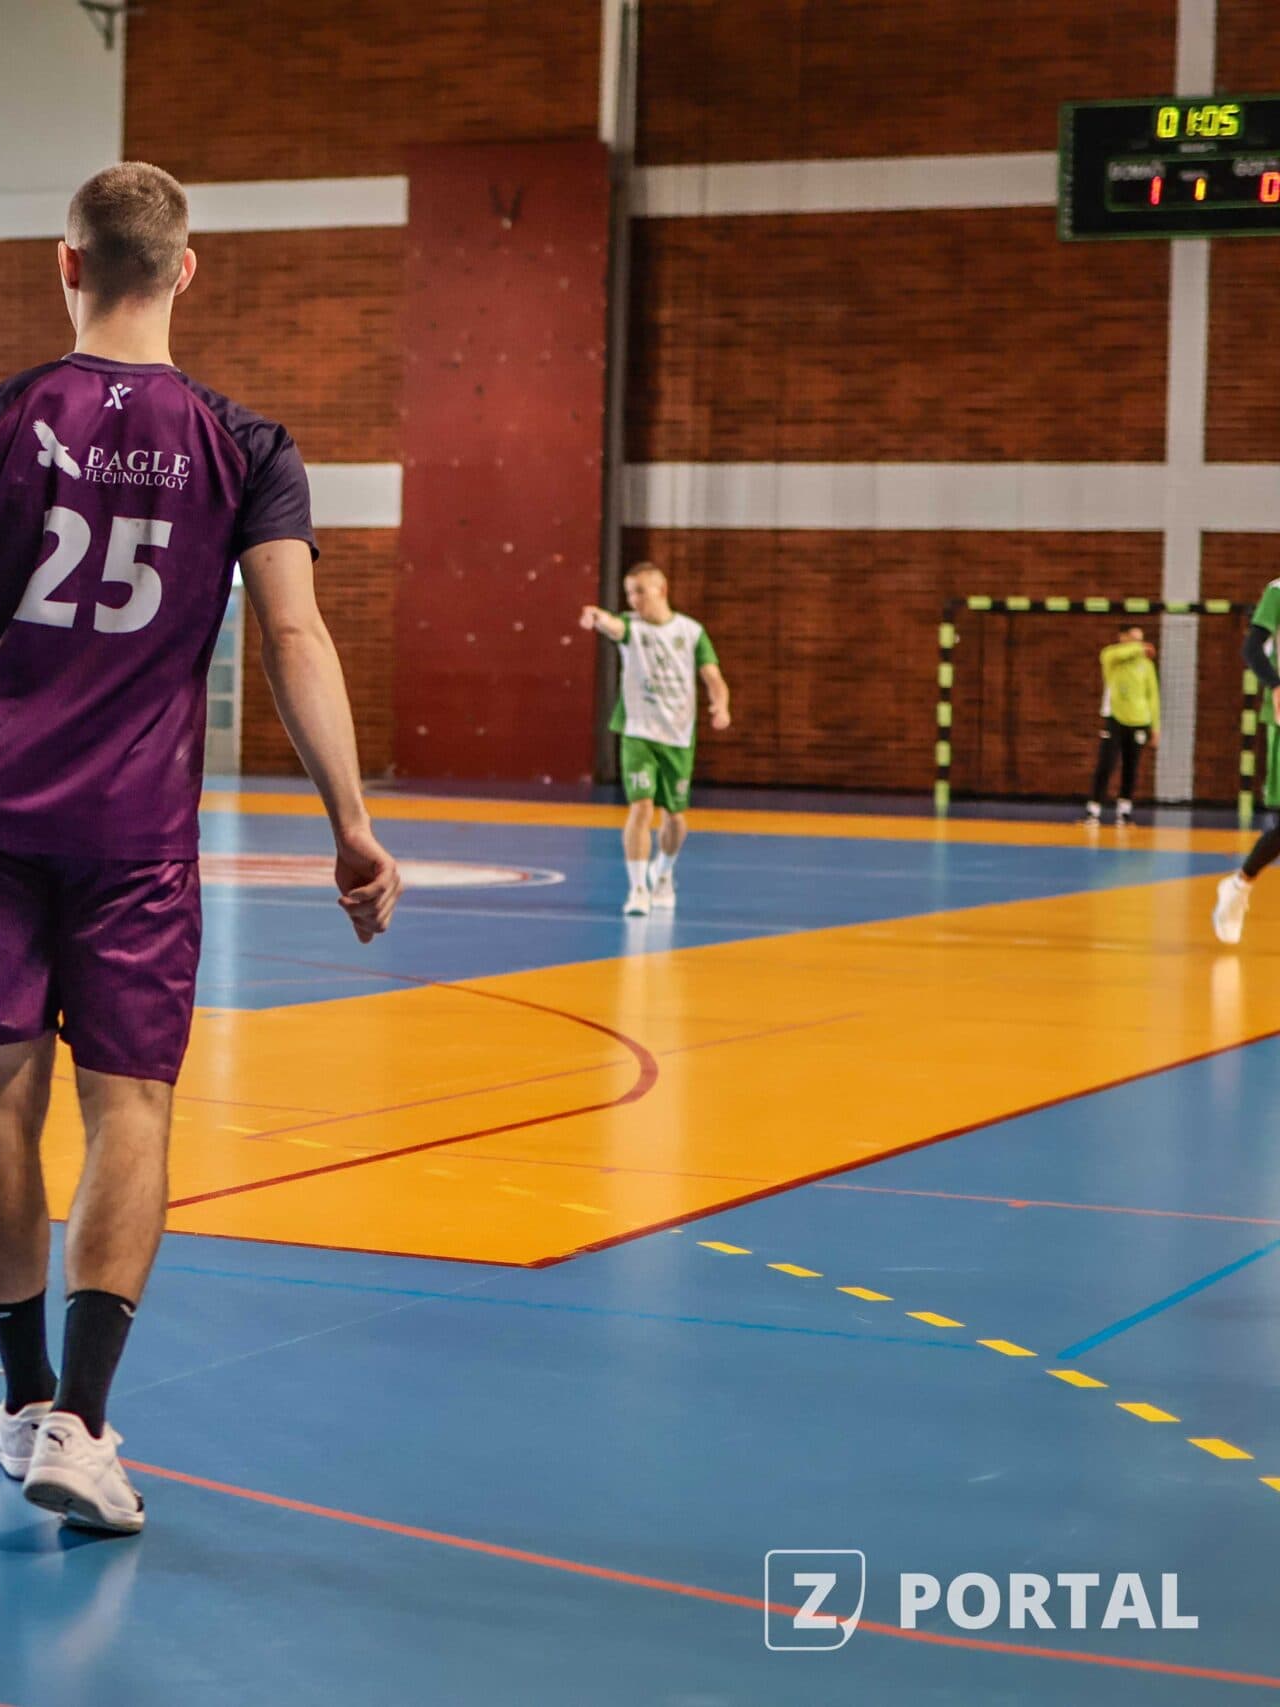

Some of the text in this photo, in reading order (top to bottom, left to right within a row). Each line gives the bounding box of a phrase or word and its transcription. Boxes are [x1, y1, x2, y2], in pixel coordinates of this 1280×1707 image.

[85, 446, 191, 478] EAGLE
[84, 467, 188, 491] TECHNOLOGY
[13, 506, 173, 633] 25
